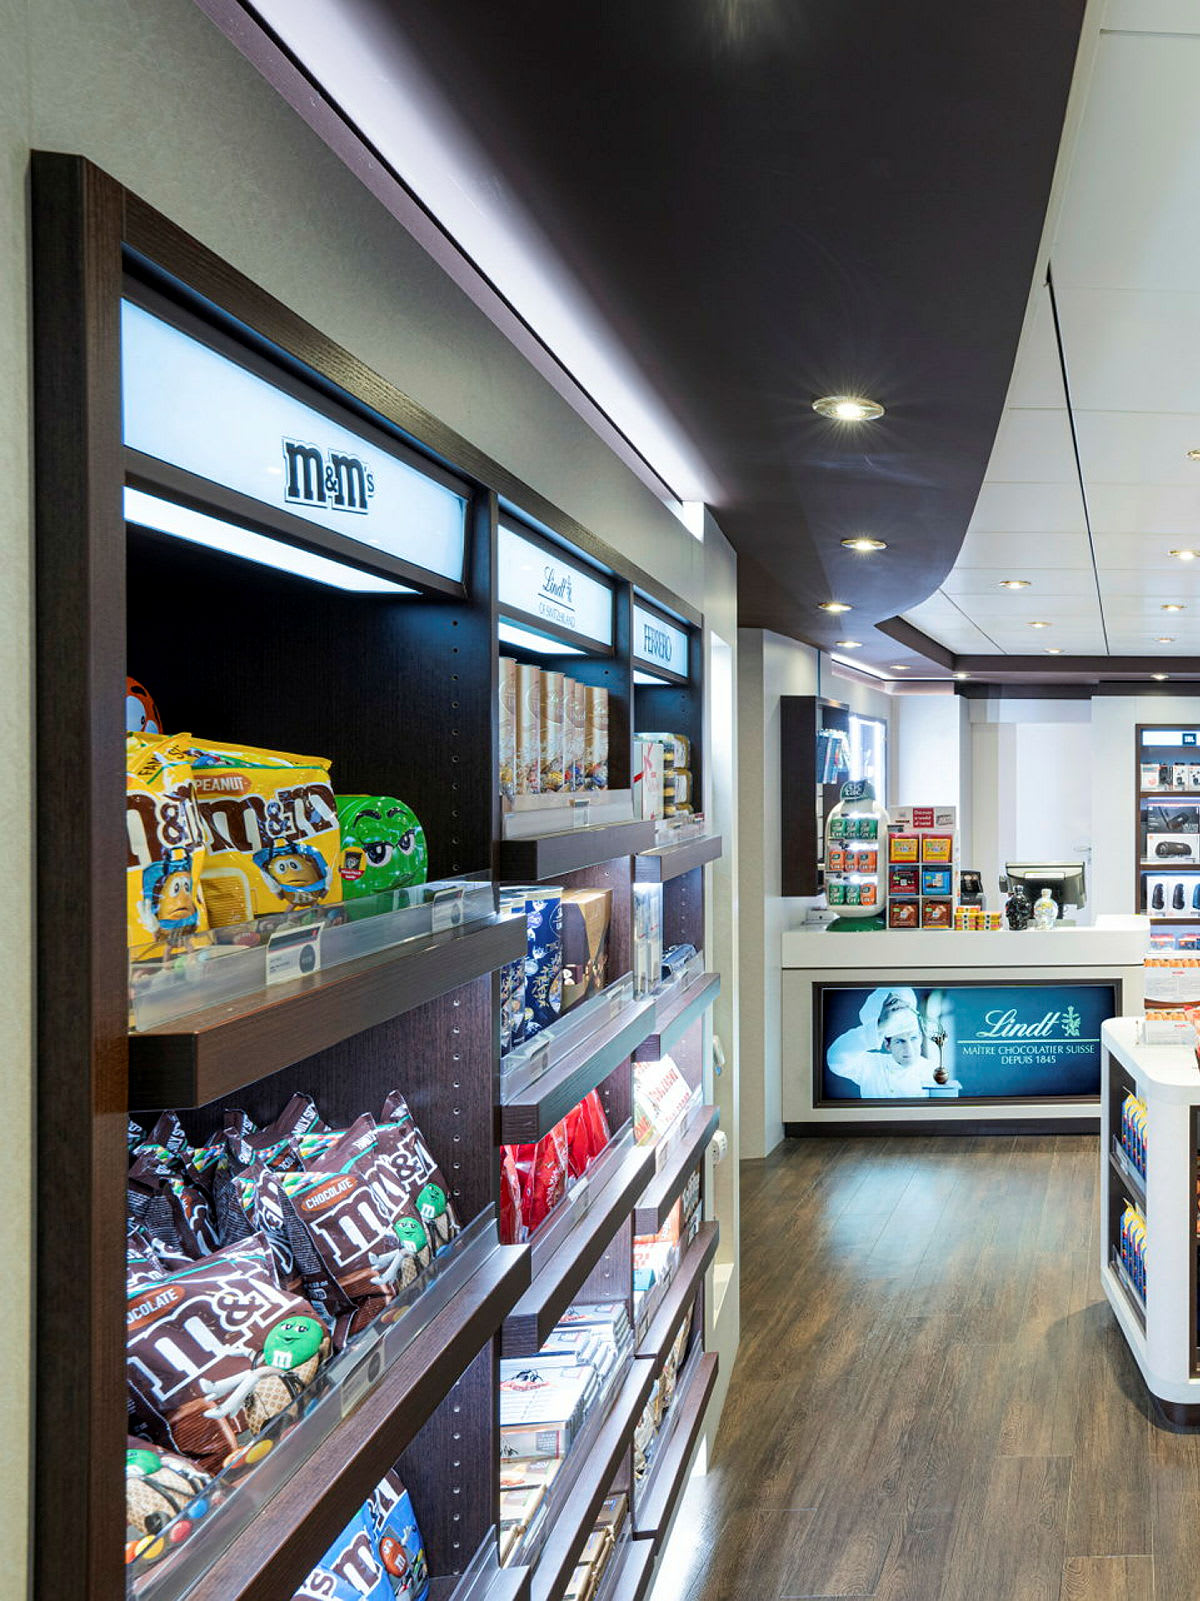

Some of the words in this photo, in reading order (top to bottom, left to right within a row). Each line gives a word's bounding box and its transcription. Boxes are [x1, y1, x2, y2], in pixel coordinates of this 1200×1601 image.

[644, 624, 672, 662] FERRERO
[195, 777, 245, 791] PEANUT
[976, 1009, 1061, 1038] Lindt
[998, 1045, 1063, 1054] CHOCOLATIER
[1067, 1044, 1095, 1053] SUISSE
[1001, 1056, 1033, 1064] DEPUIS
[1036, 1055, 1056, 1063] 1845
[305, 1180, 354, 1209] CHOCOLATE
